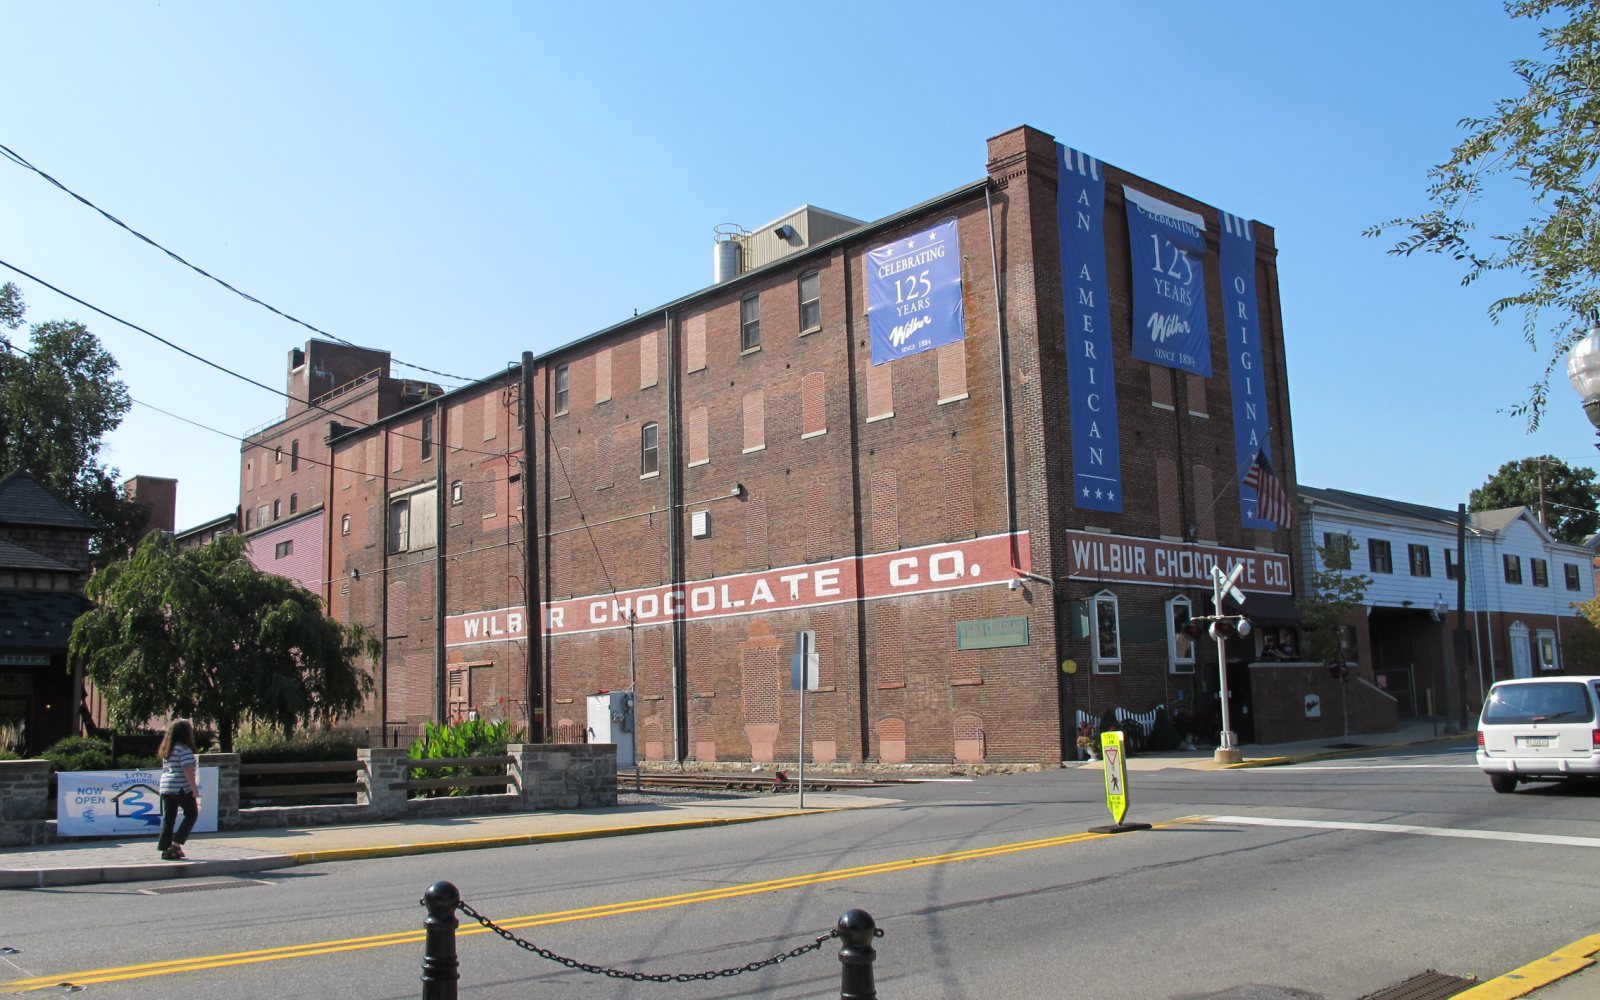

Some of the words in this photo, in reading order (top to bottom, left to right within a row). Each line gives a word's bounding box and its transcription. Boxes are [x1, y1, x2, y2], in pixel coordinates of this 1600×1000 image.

[1077, 188, 1091, 232] AN
[1136, 205, 1200, 238] CLEBRATING
[878, 245, 945, 279] CELEBRATING
[1150, 234, 1193, 286] 125
[894, 270, 932, 304] 125
[1153, 278, 1192, 306] YEARS
[896, 297, 931, 317] YEARS
[889, 315, 932, 348] Wilbur
[1147, 312, 1191, 343] Wilbur
[901, 344, 917, 354] SINCE
[1079, 263, 1103, 467] AMERICAN
[1155, 348, 1175, 362] SINCE
[1179, 352, 1196, 367] 1884
[1234, 275, 1260, 462] ORIGINA
[1071, 539, 1146, 575] WILBUR
[1263, 560, 1288, 587] CO.
[463, 606, 565, 639] WILBR
[589, 567, 841, 625] CHOCOLATE
[888, 549, 981, 588] CO.
[75, 796, 105, 805] OPEN
[77, 787, 104, 795] NOW
